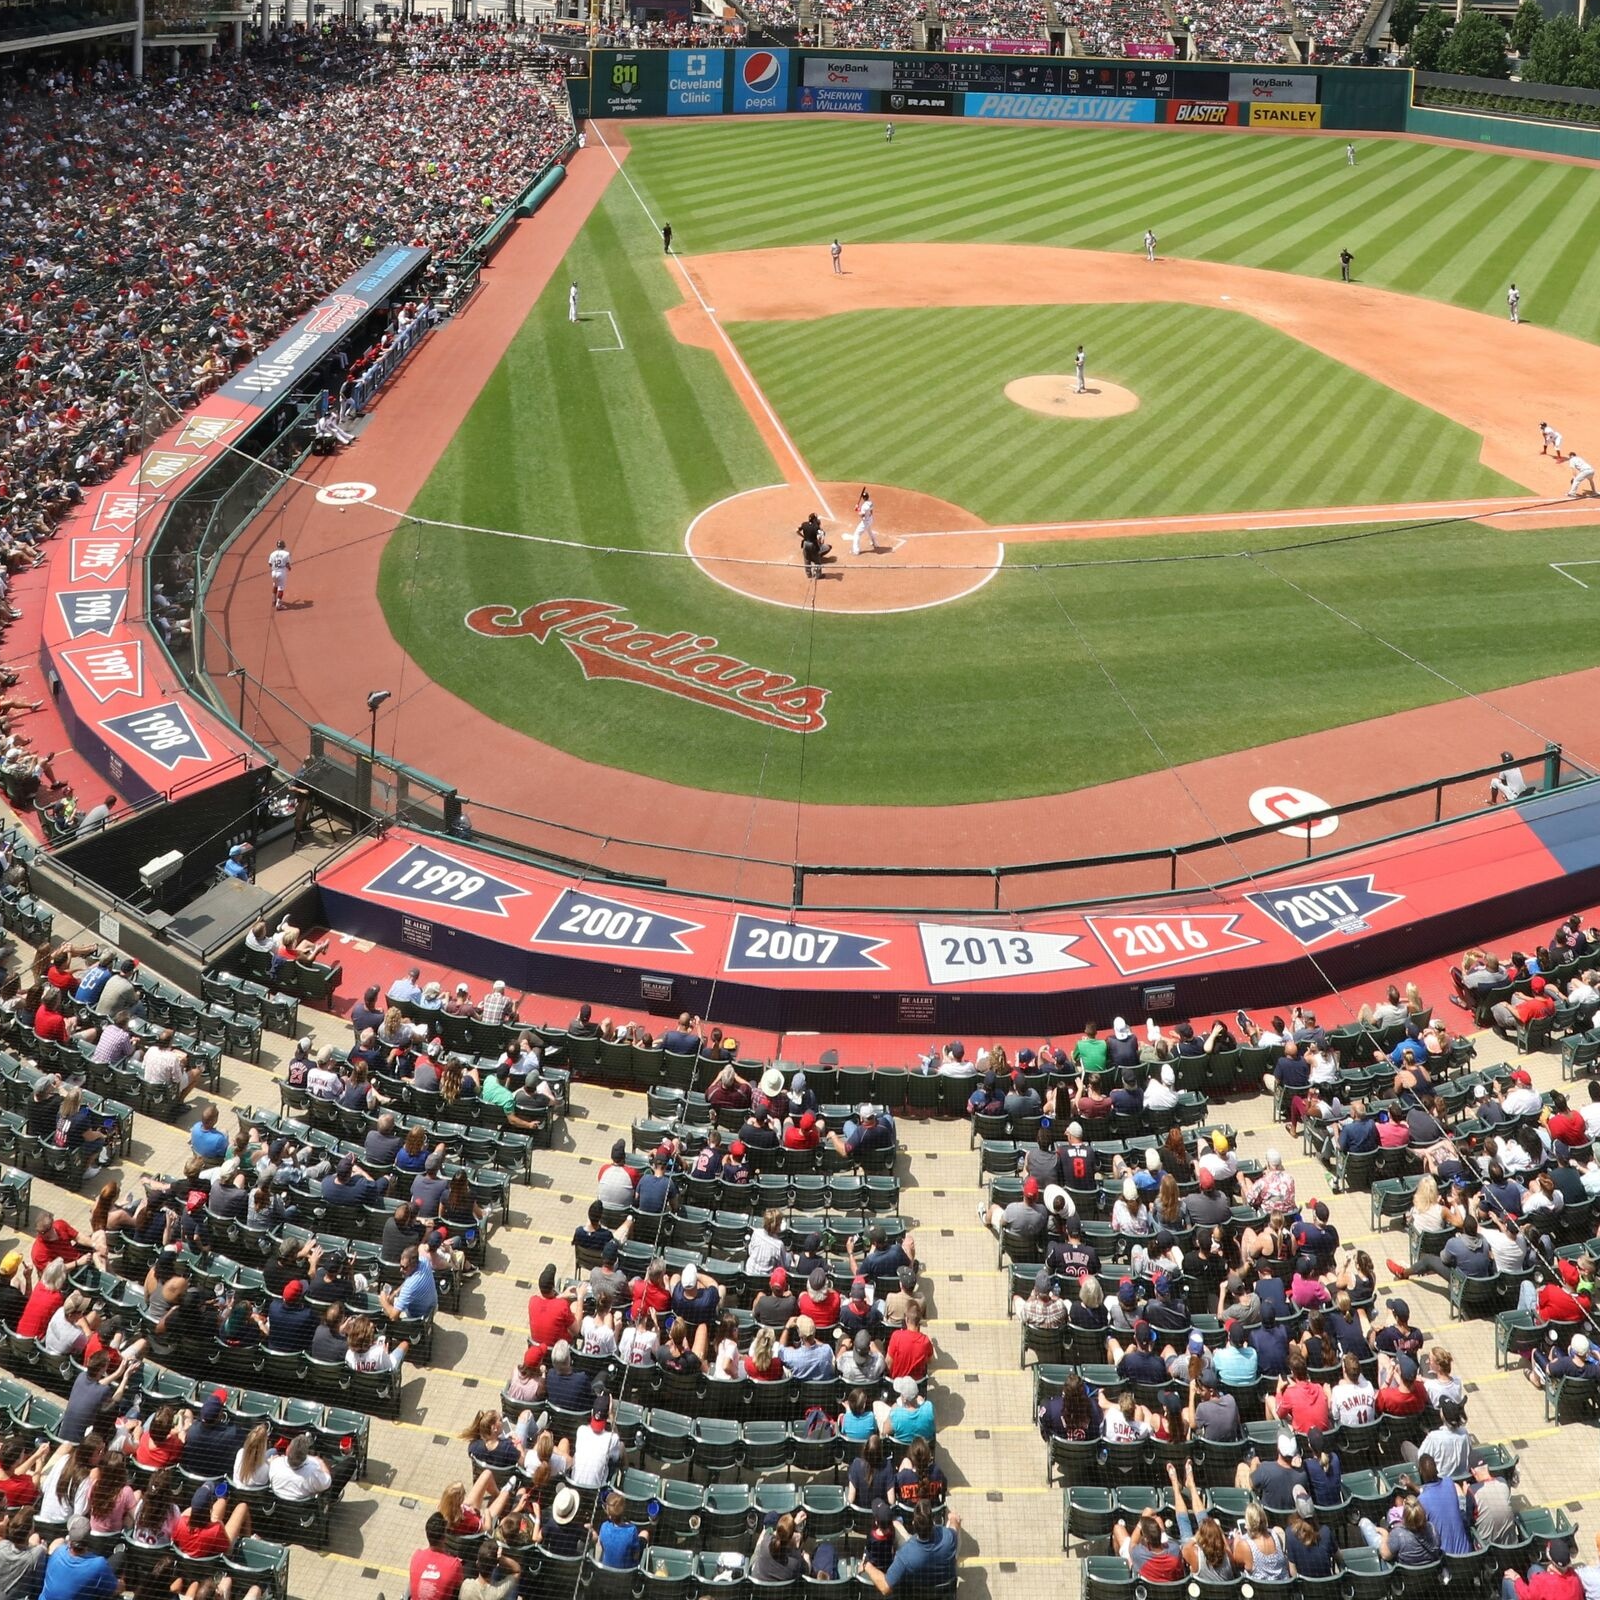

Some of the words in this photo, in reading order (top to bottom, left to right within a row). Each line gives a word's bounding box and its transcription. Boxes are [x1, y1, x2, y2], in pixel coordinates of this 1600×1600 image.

[613, 65, 638, 84] 811
[827, 63, 869, 73] KeyBank
[669, 78, 723, 90] Cleveland
[1252, 78, 1293, 88] KeyBank
[680, 92, 711, 104] Clinic
[745, 96, 776, 109] pepsi
[817, 90, 863, 101] SHERWIN
[907, 99, 945, 107] RAM
[978, 95, 1137, 121] PROGRESSIVE
[1175, 104, 1228, 122] BLASTER
[1254, 109, 1317, 122] STANLEY
[145, 456, 188, 477] 1948
[104, 497, 146, 520] 1954
[79, 542, 121, 568] 1995
[74, 593, 112, 624] 1996
[85, 650, 134, 681] 1997
[464, 598, 833, 734] Indians
[127, 712, 191, 751] 1998
[397, 859, 486, 901] 1999
[1273, 884, 1360, 929] 2017
[558, 903, 654, 945] 2001
[744, 928, 839, 965] 2007
[1112, 920, 1209, 958] 2016
[939, 937, 1034, 966] 2013
[1073, 1157, 1086, 1179] 8
